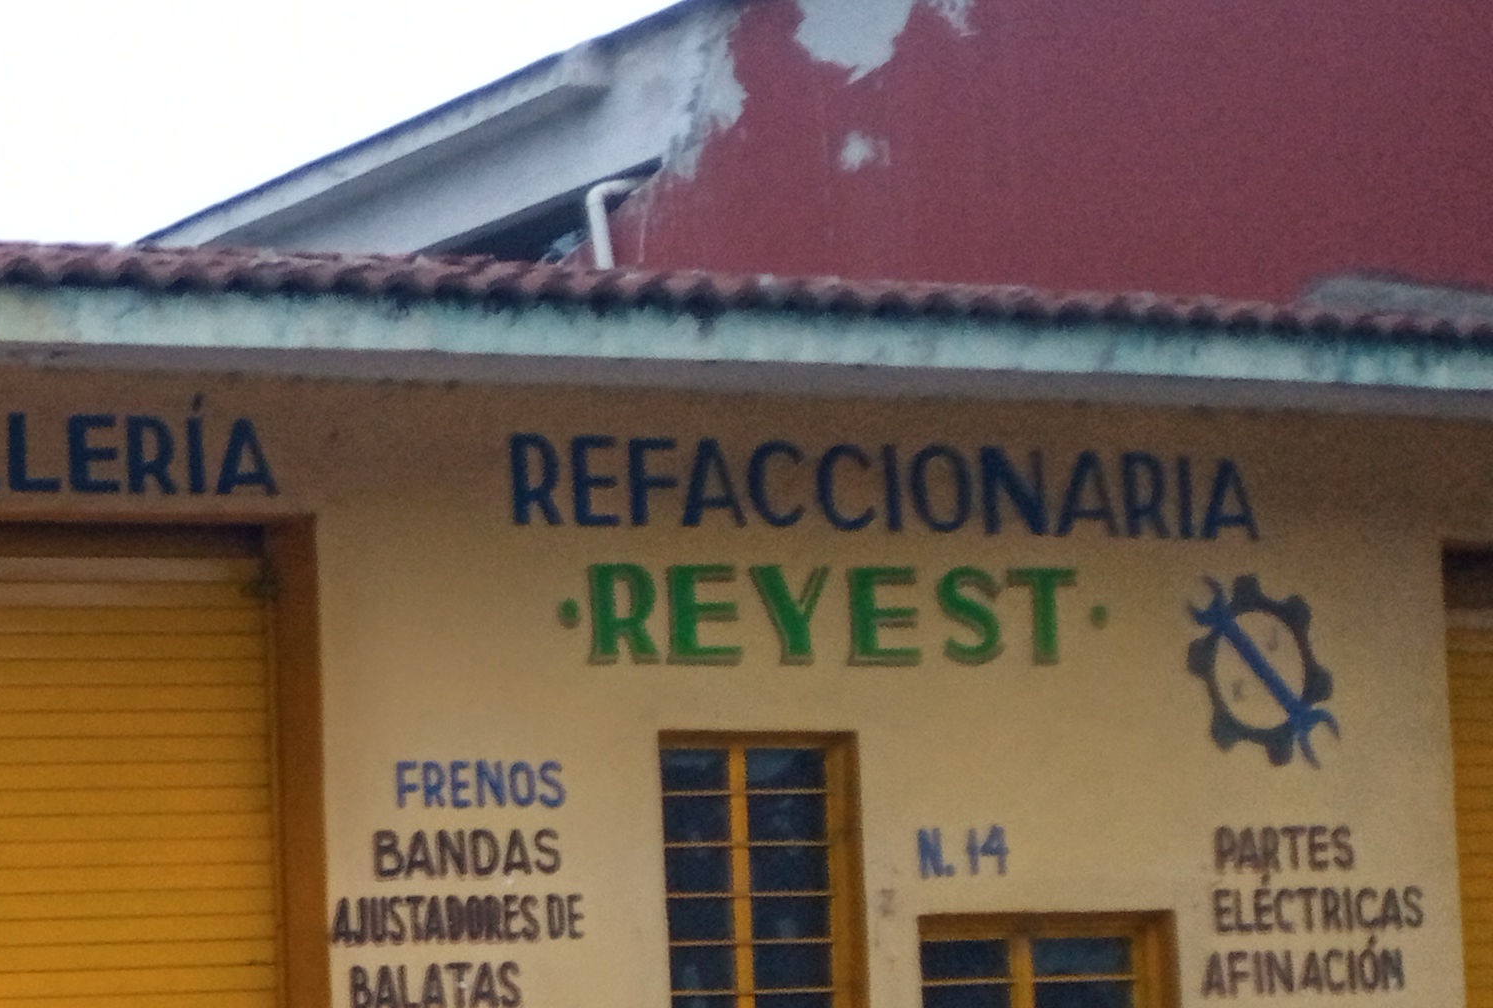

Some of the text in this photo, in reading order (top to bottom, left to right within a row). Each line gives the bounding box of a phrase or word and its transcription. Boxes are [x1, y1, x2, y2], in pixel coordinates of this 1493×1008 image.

[509, 431, 1261, 541] REFACCIONARIA
[396, 760, 567, 808] FRENOS
[373, 828, 562, 881] BANDAS
[966, 825, 1009, 876] 14
[1214, 825, 1355, 873] PARTES
[331, 893, 585, 945] AJUSTADORES DE
[1214, 873, 1424, 934] ELÉCTRICAS
[1201, 936, 1406, 997] AFINACIÓN
